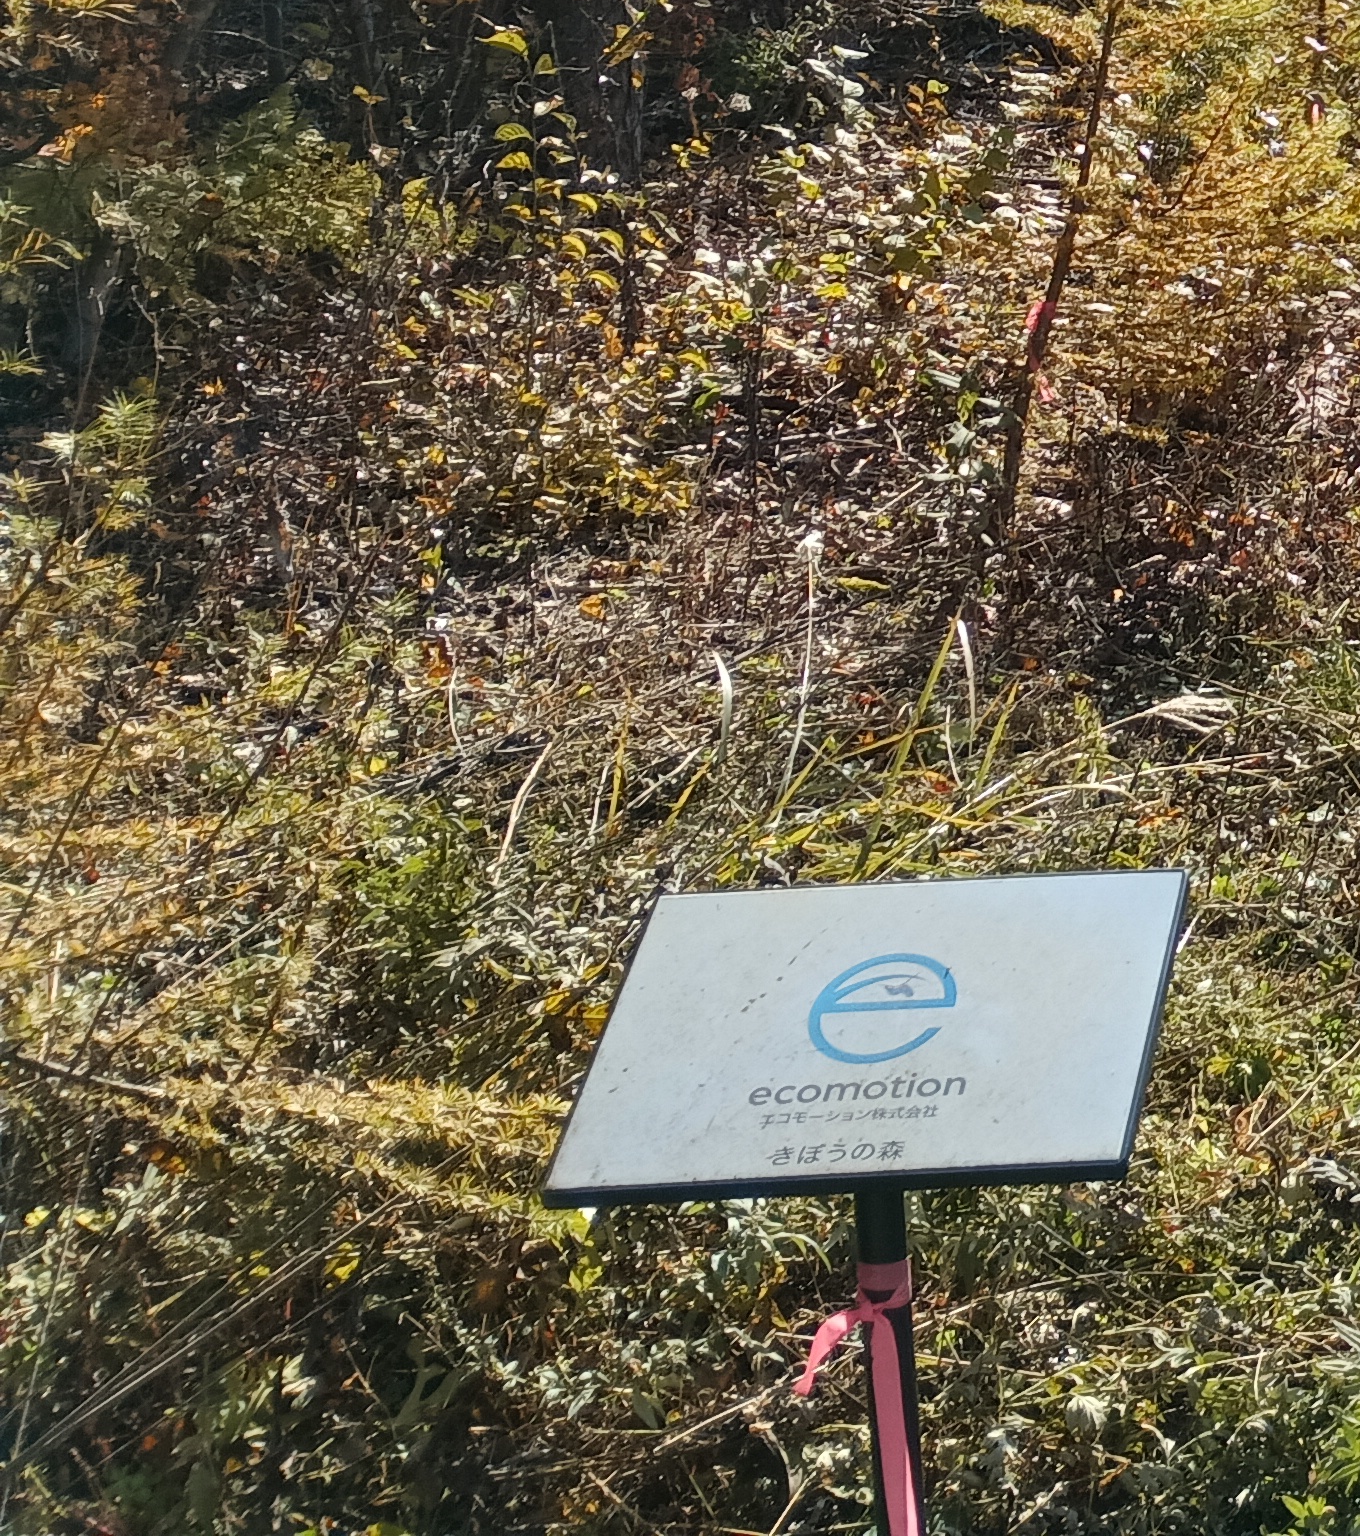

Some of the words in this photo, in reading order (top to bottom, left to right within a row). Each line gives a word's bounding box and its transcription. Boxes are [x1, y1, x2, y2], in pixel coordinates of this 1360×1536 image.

[748, 1073, 966, 1106] ecomotion
[761, 1105, 938, 1127] エコモーション株式会社
[770, 1140, 904, 1166] きぼうの森
